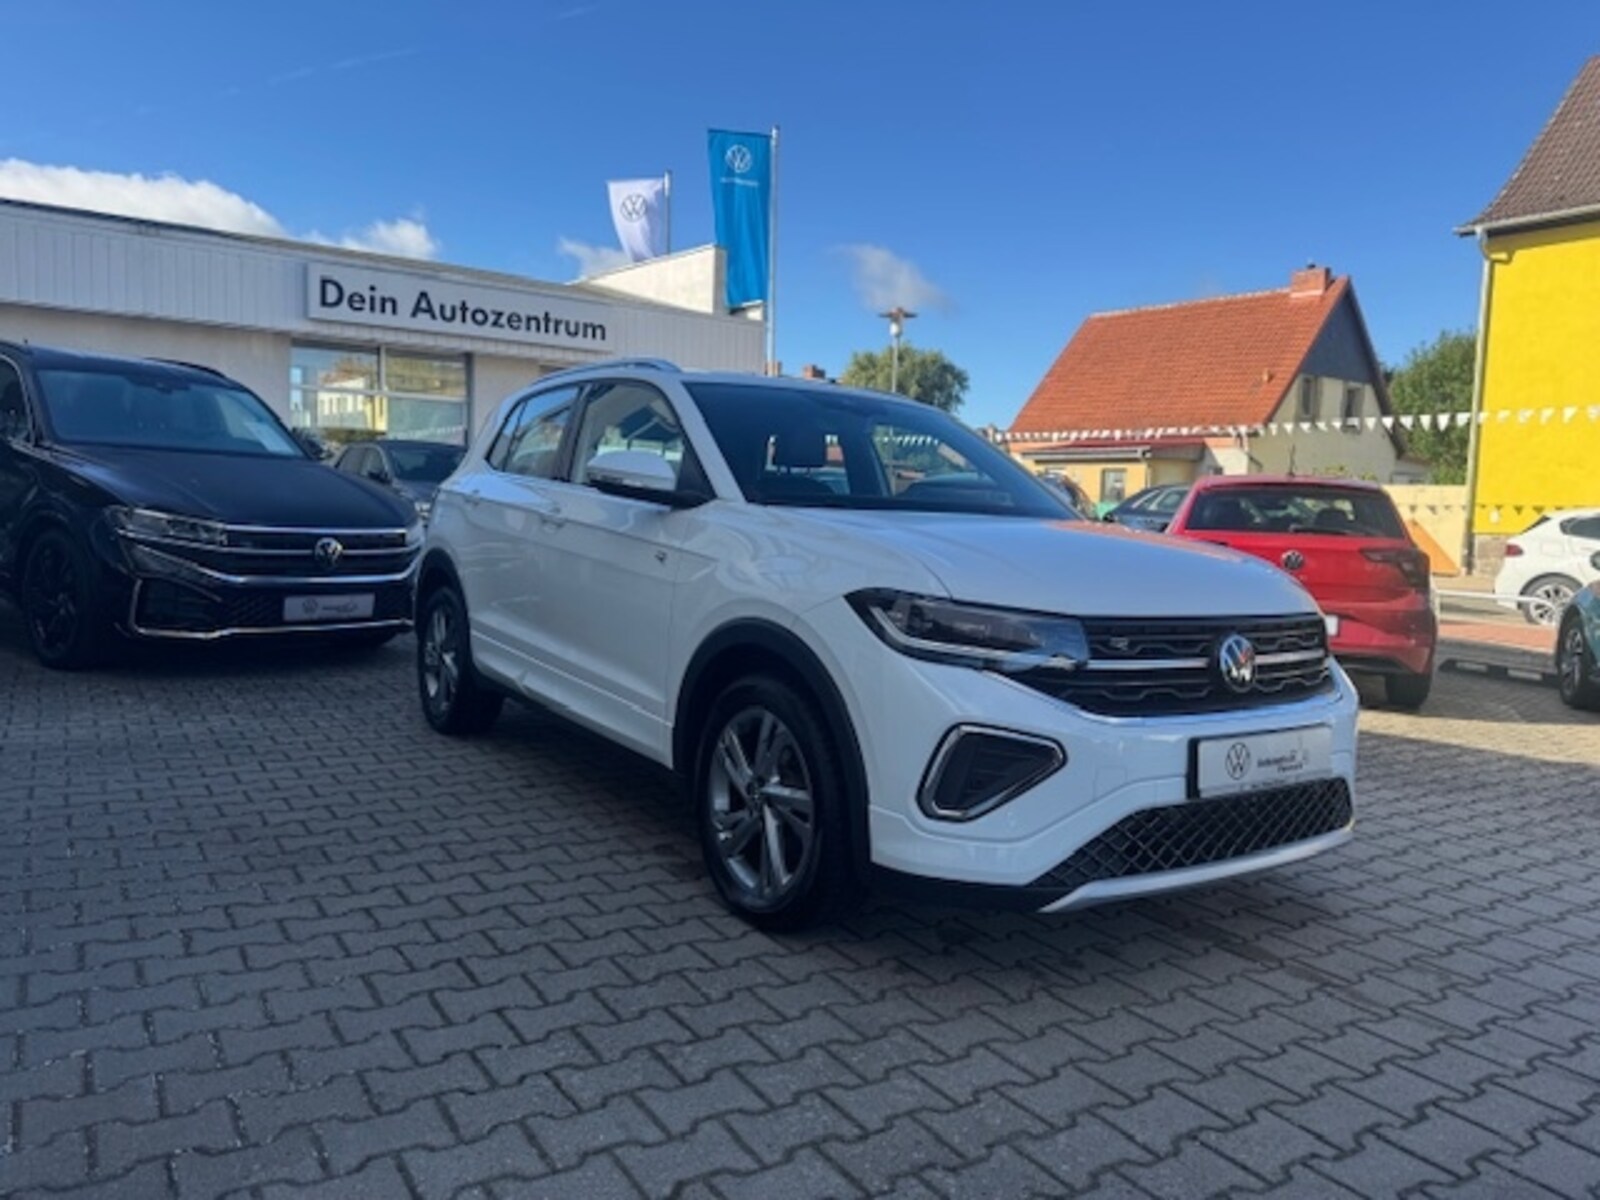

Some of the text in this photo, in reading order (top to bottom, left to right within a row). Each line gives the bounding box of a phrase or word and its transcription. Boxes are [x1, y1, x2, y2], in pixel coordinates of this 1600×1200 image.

[620, 194, 647, 223] VW
[318, 274, 607, 341] Dein Autozentrum
[1224, 742, 1250, 780] VW
